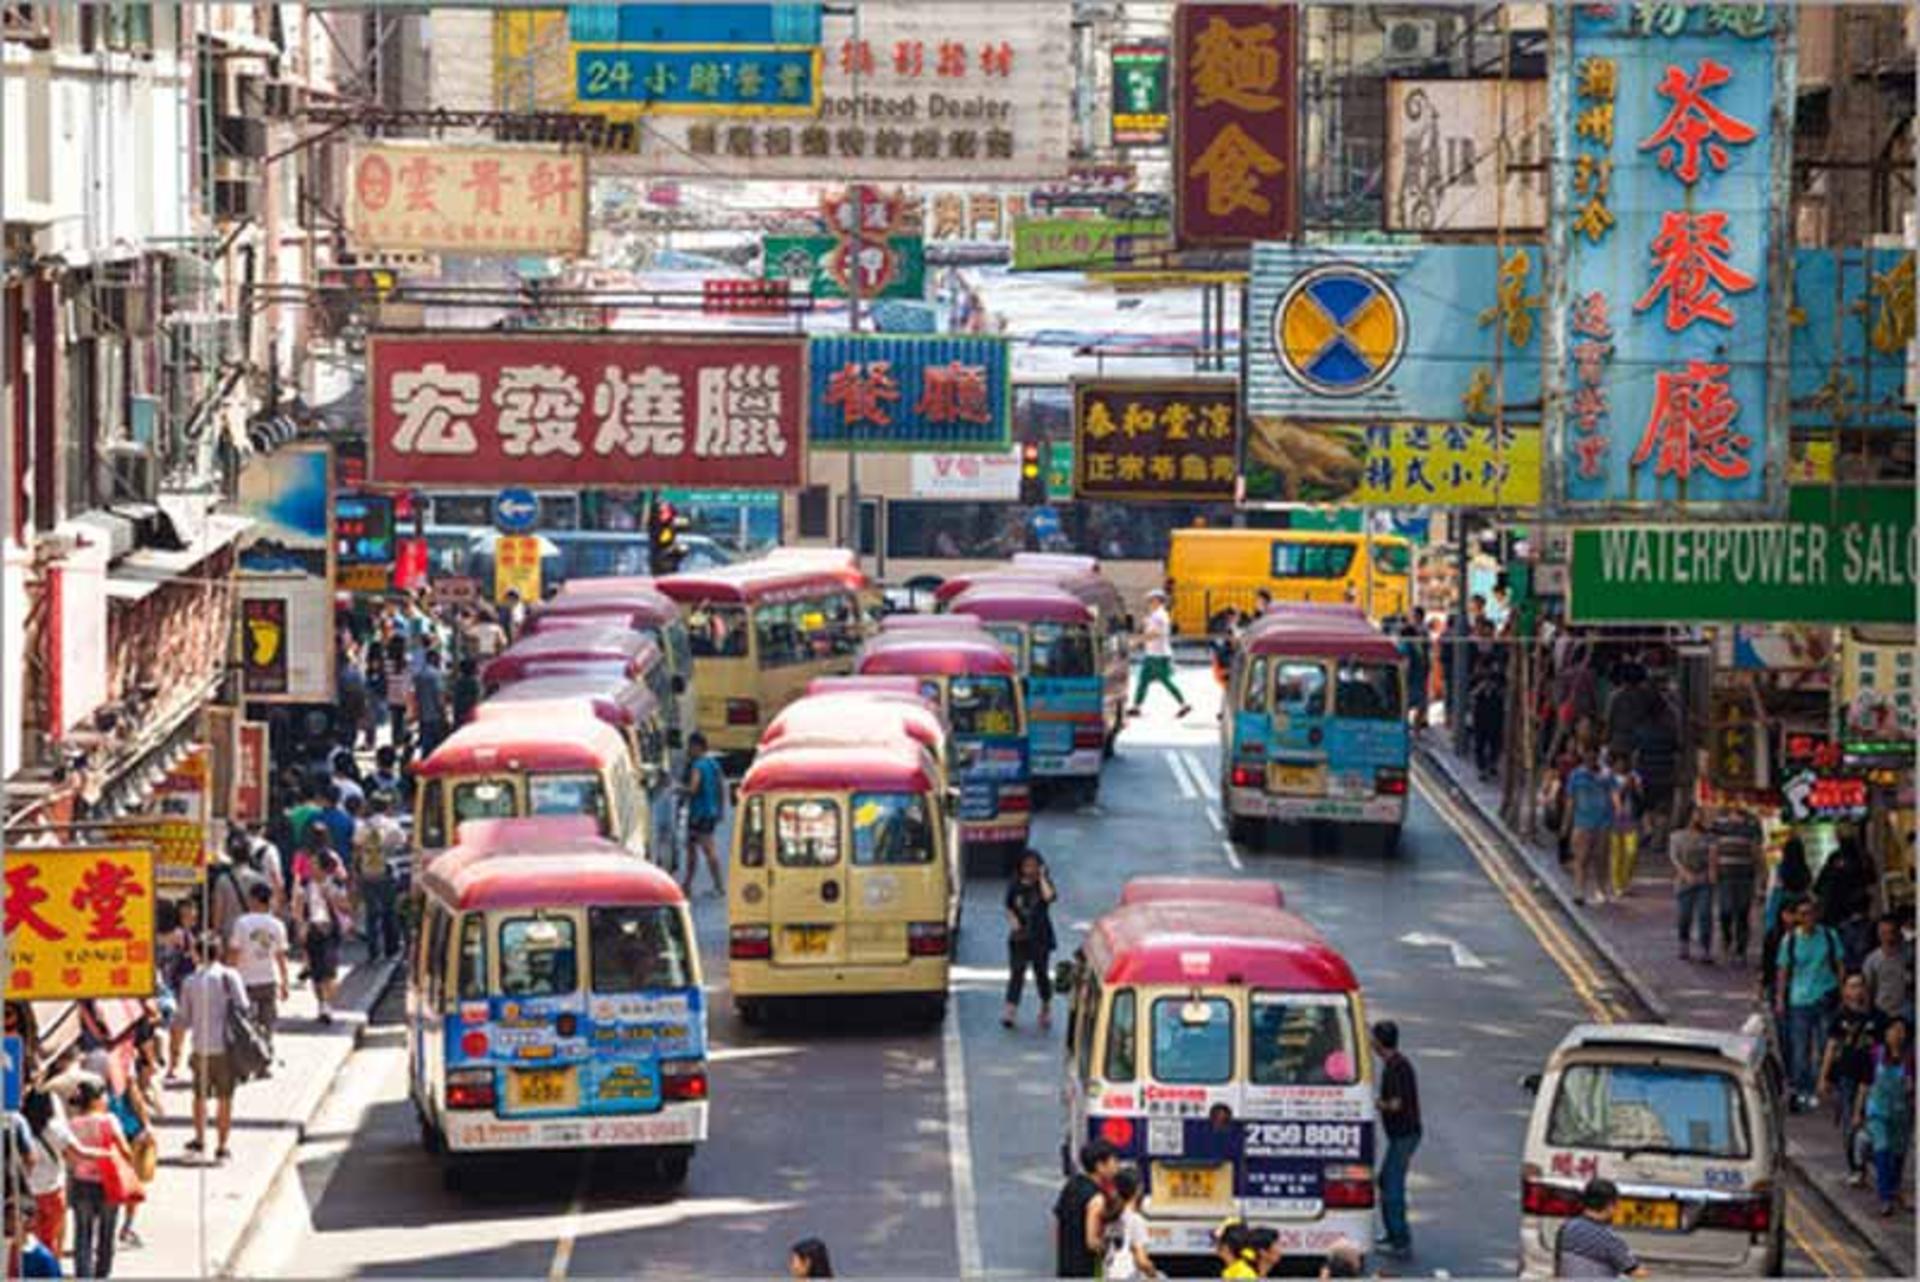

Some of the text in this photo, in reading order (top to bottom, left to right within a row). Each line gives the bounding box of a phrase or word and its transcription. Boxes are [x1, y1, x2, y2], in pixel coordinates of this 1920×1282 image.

[928, 94, 1011, 119] Dealer
[1637, 58, 1758, 479] 茶餐廳
[389, 362, 788, 457] 宏發燒臘
[823, 360, 991, 427] 餐廳
[1601, 526, 1828, 585] WATERPOWER
[1305, 1124, 1361, 1146] 8001
